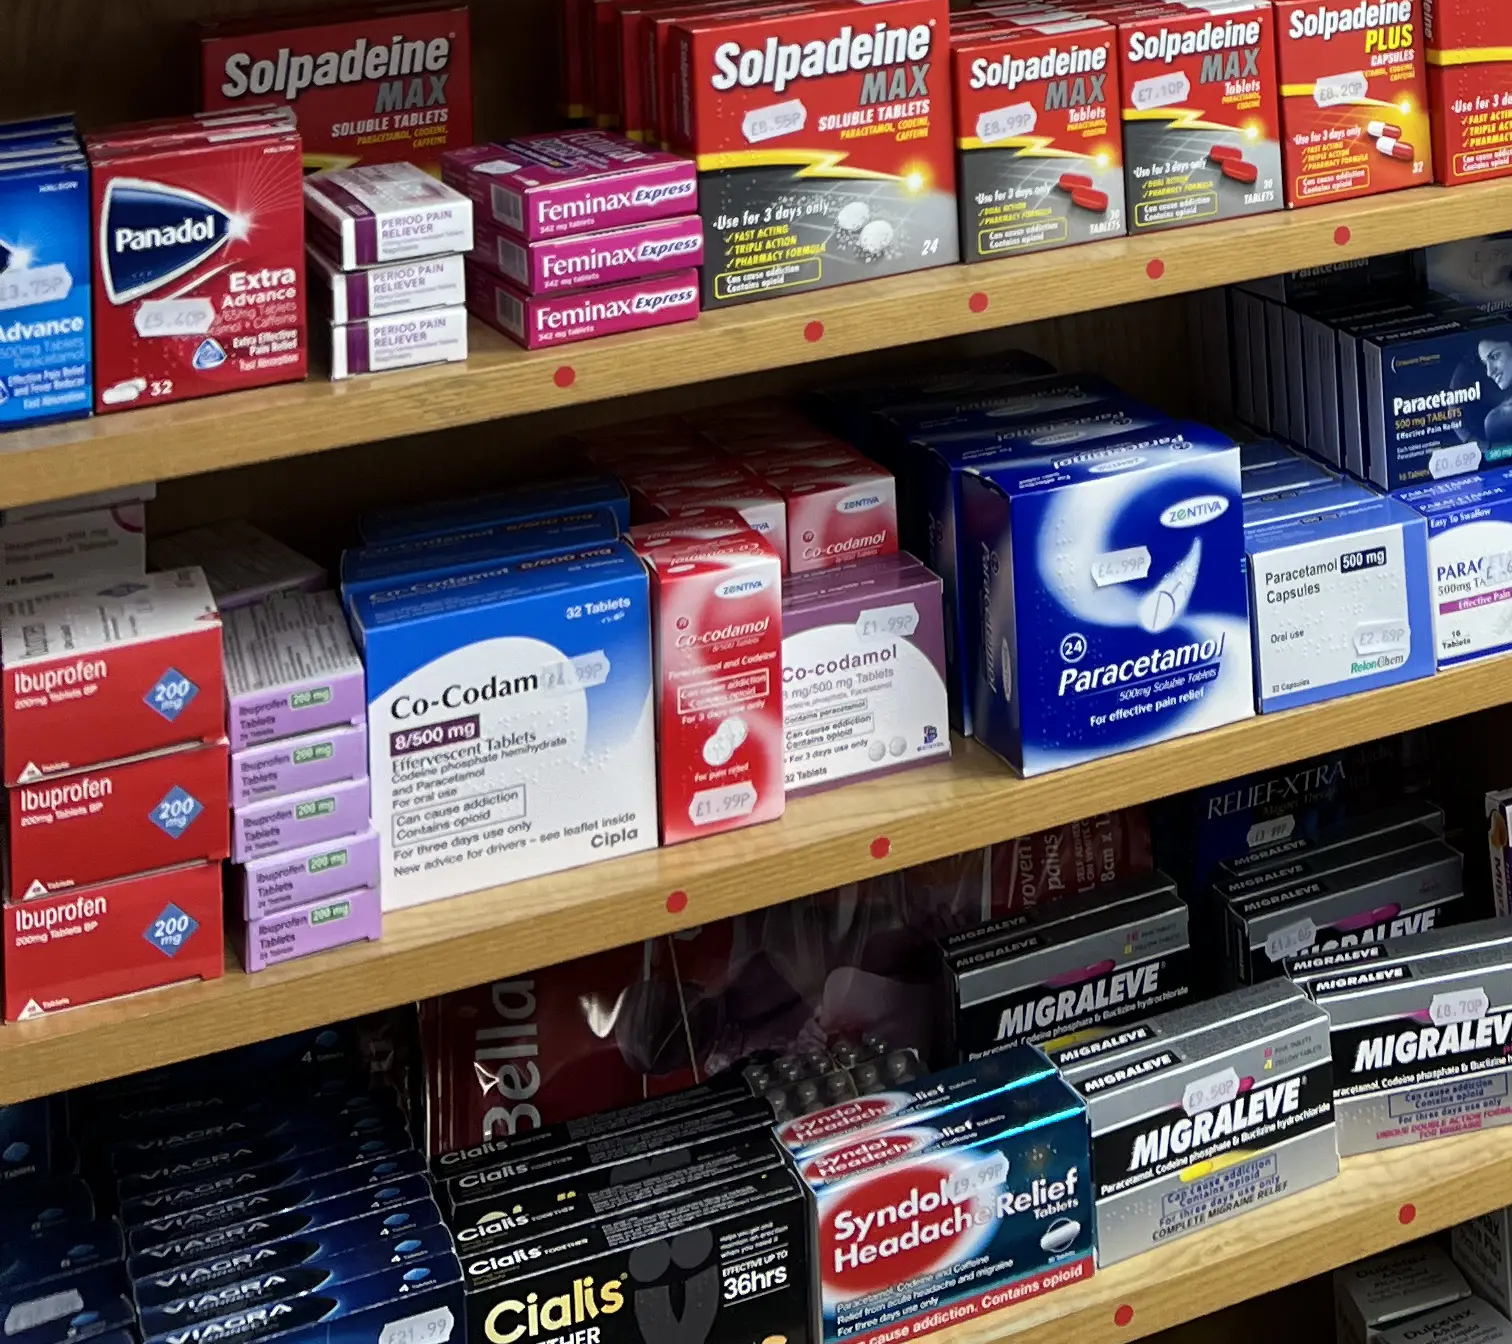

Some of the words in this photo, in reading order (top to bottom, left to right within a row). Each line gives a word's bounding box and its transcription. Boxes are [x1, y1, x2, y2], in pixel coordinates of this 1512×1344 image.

[1289, 0, 1412, 39] Solpadeine
[1364, 23, 1413, 53] PLUS
[710, 21, 931, 92] Solpadeine
[1128, 20, 1261, 62] Solpadeine
[1371, 49, 1414, 65] CAPSULES
[969, 44, 1107, 90] Solpadeine
[1200, 48, 1260, 84] MAX
[1044, 75, 1106, 112] MAX
[818, 107, 874, 132] SOLUBLE
[878, 99, 930, 121] TABLETS
[115, 214, 215, 254] Panadol
[381, 214, 415, 229] PERIOD
[419, 210, 452, 223] PAIN
[381, 223, 434, 239] RELIEVER
[221, 285, 296, 308] Advance
[229, 267, 296, 290] Extra
[537, 299, 632, 332] Feminax
[634, 287, 693, 311] Express
[1393, 382, 1481, 415] Paracetamol
[1266, 558, 1338, 587] Paracetamol
[1343, 552, 1363, 569] 500
[1366, 549, 1385, 566] mg
[1266, 582, 1320, 605] Capsules
[1057, 633, 1226, 697] Paracetamol
[391, 741, 483, 773] Effervescent
[485, 729, 536, 753] Tablets
[394, 726, 443, 752] 8/500
[447, 719, 476, 743] mg
[589, 828, 639, 851] Cipla
[16, 894, 107, 932] Ibuprofen
[1129, 1077, 1302, 1172] MIGRALEVE
[833, 1177, 950, 1241] Syndol
[997, 1166, 1078, 1219] Relief
[724, 1265, 787, 1302] 36hrs
[485, 1277, 626, 1343] Cialis
